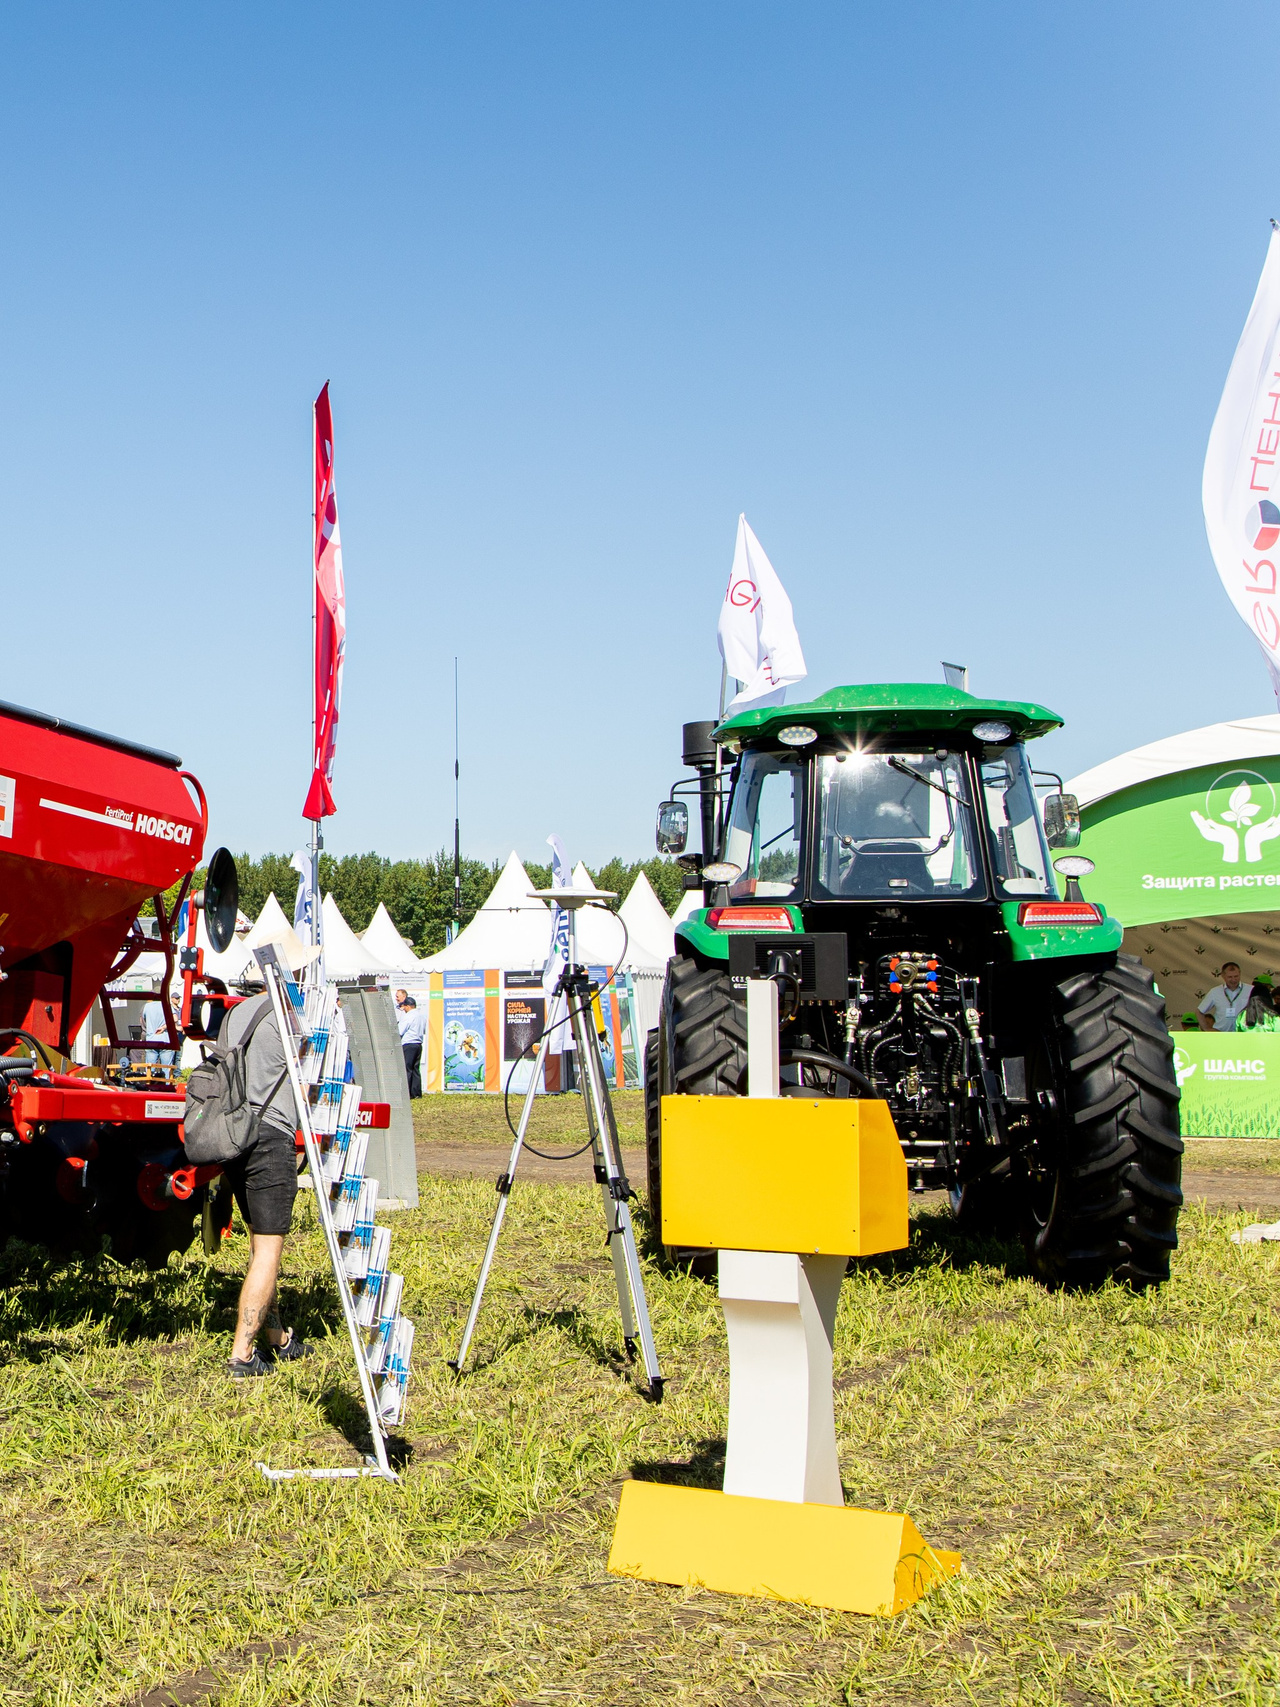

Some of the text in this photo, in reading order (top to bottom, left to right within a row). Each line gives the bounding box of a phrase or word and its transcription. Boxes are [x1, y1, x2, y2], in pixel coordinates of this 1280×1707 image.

[105, 806, 134, 822] FertiProf
[135, 813, 193, 846] HORSCH
[1142, 874, 1215, 891] Защита
[1204, 1059, 1265, 1074] ШАНС
[354, 1110, 373, 1126] SCH
